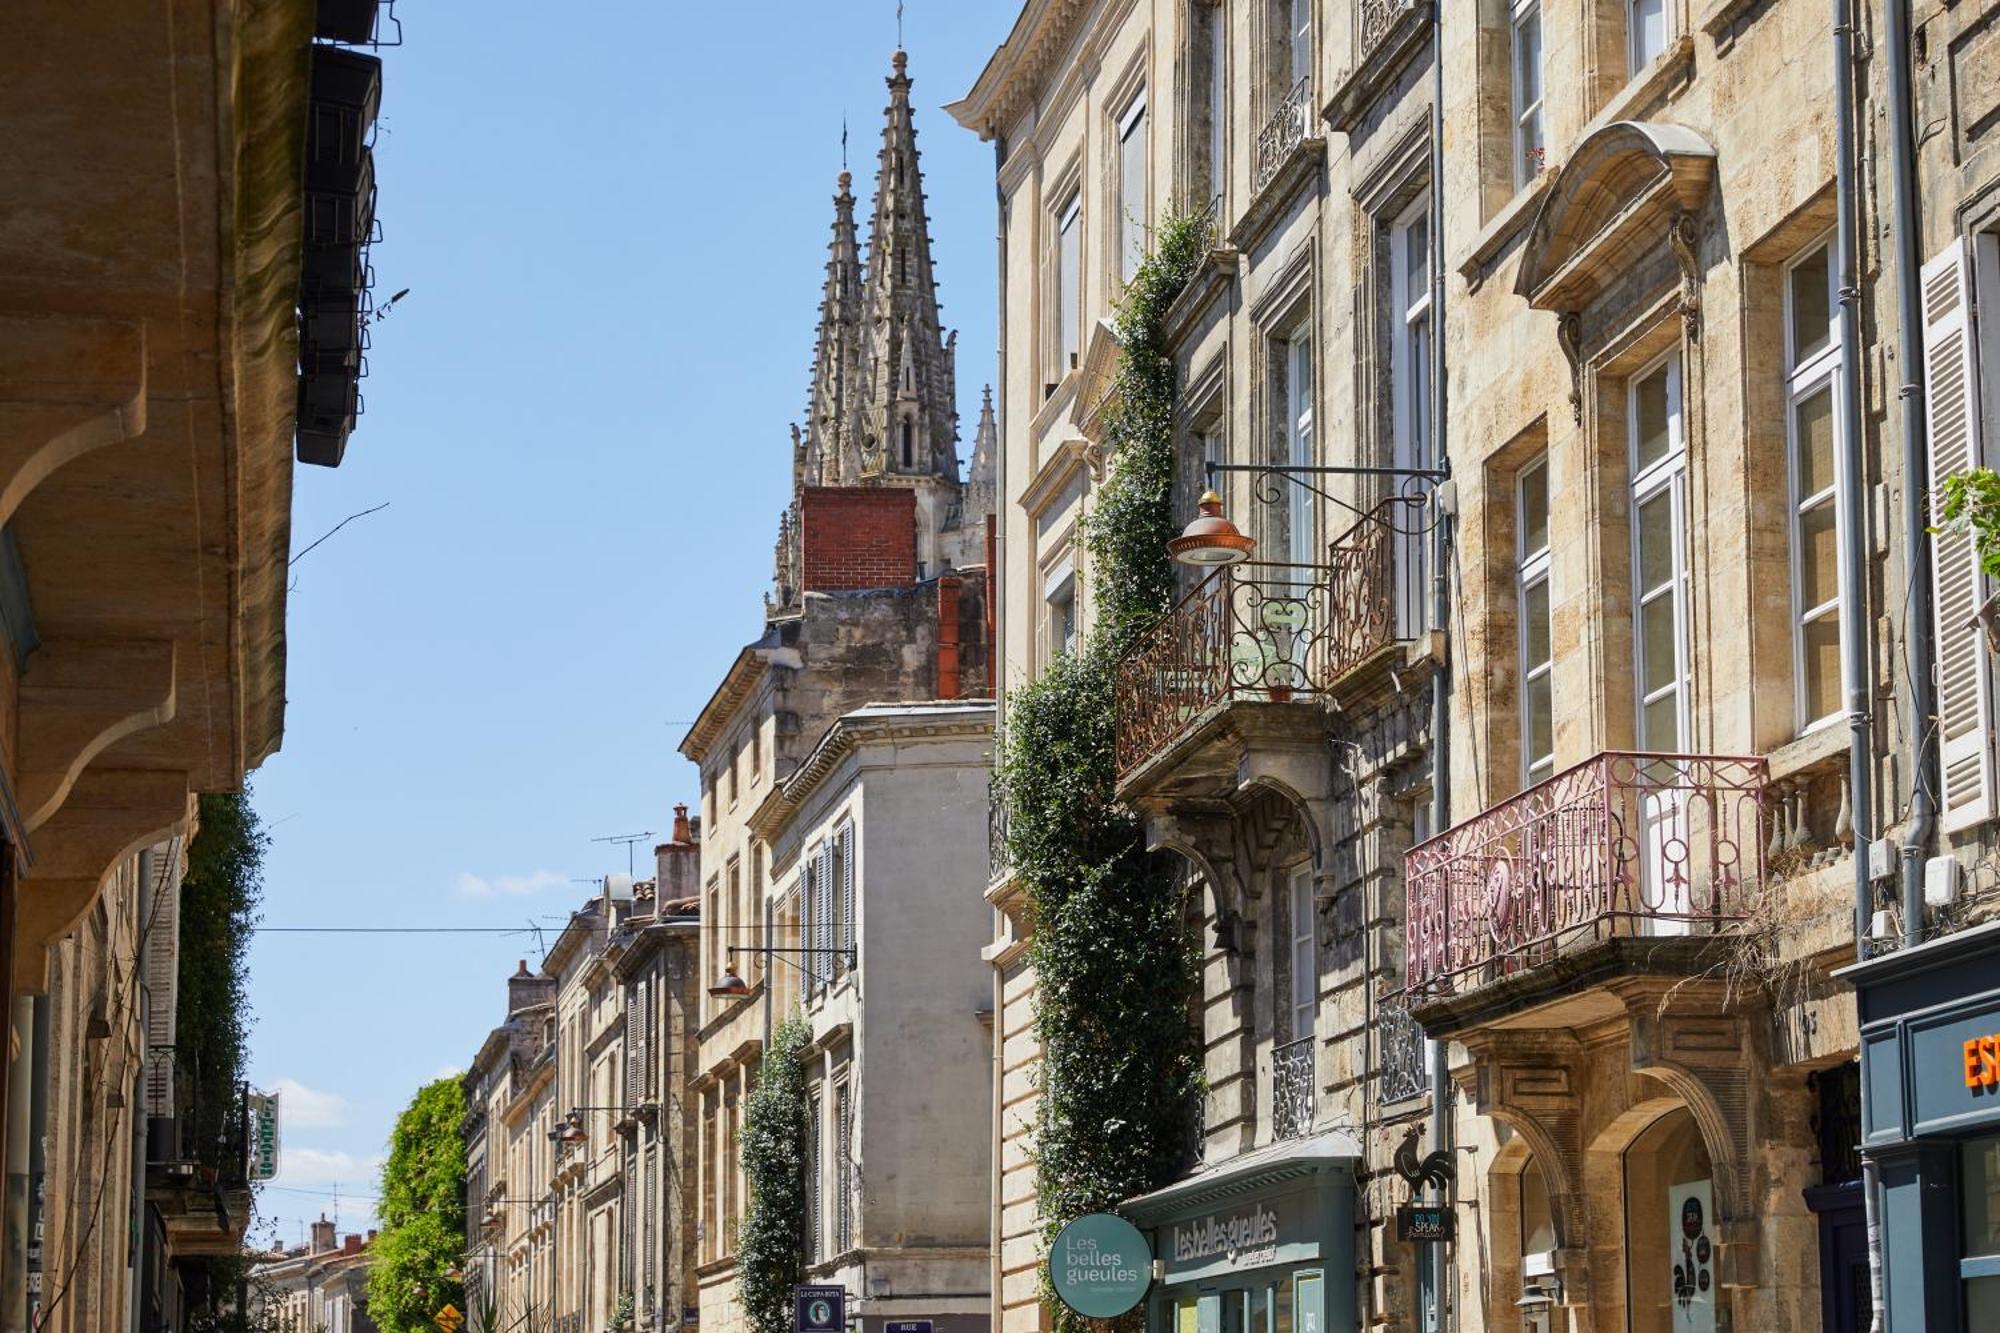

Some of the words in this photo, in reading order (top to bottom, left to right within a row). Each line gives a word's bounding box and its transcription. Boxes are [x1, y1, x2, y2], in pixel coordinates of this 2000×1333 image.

[1414, 1221, 1440, 1233] SPEAK
[1066, 1236, 1097, 1250] Les
[1066, 1250, 1122, 1266] belles
[1066, 1266, 1137, 1286] gueules
[900, 1323, 917, 1332] RUE
